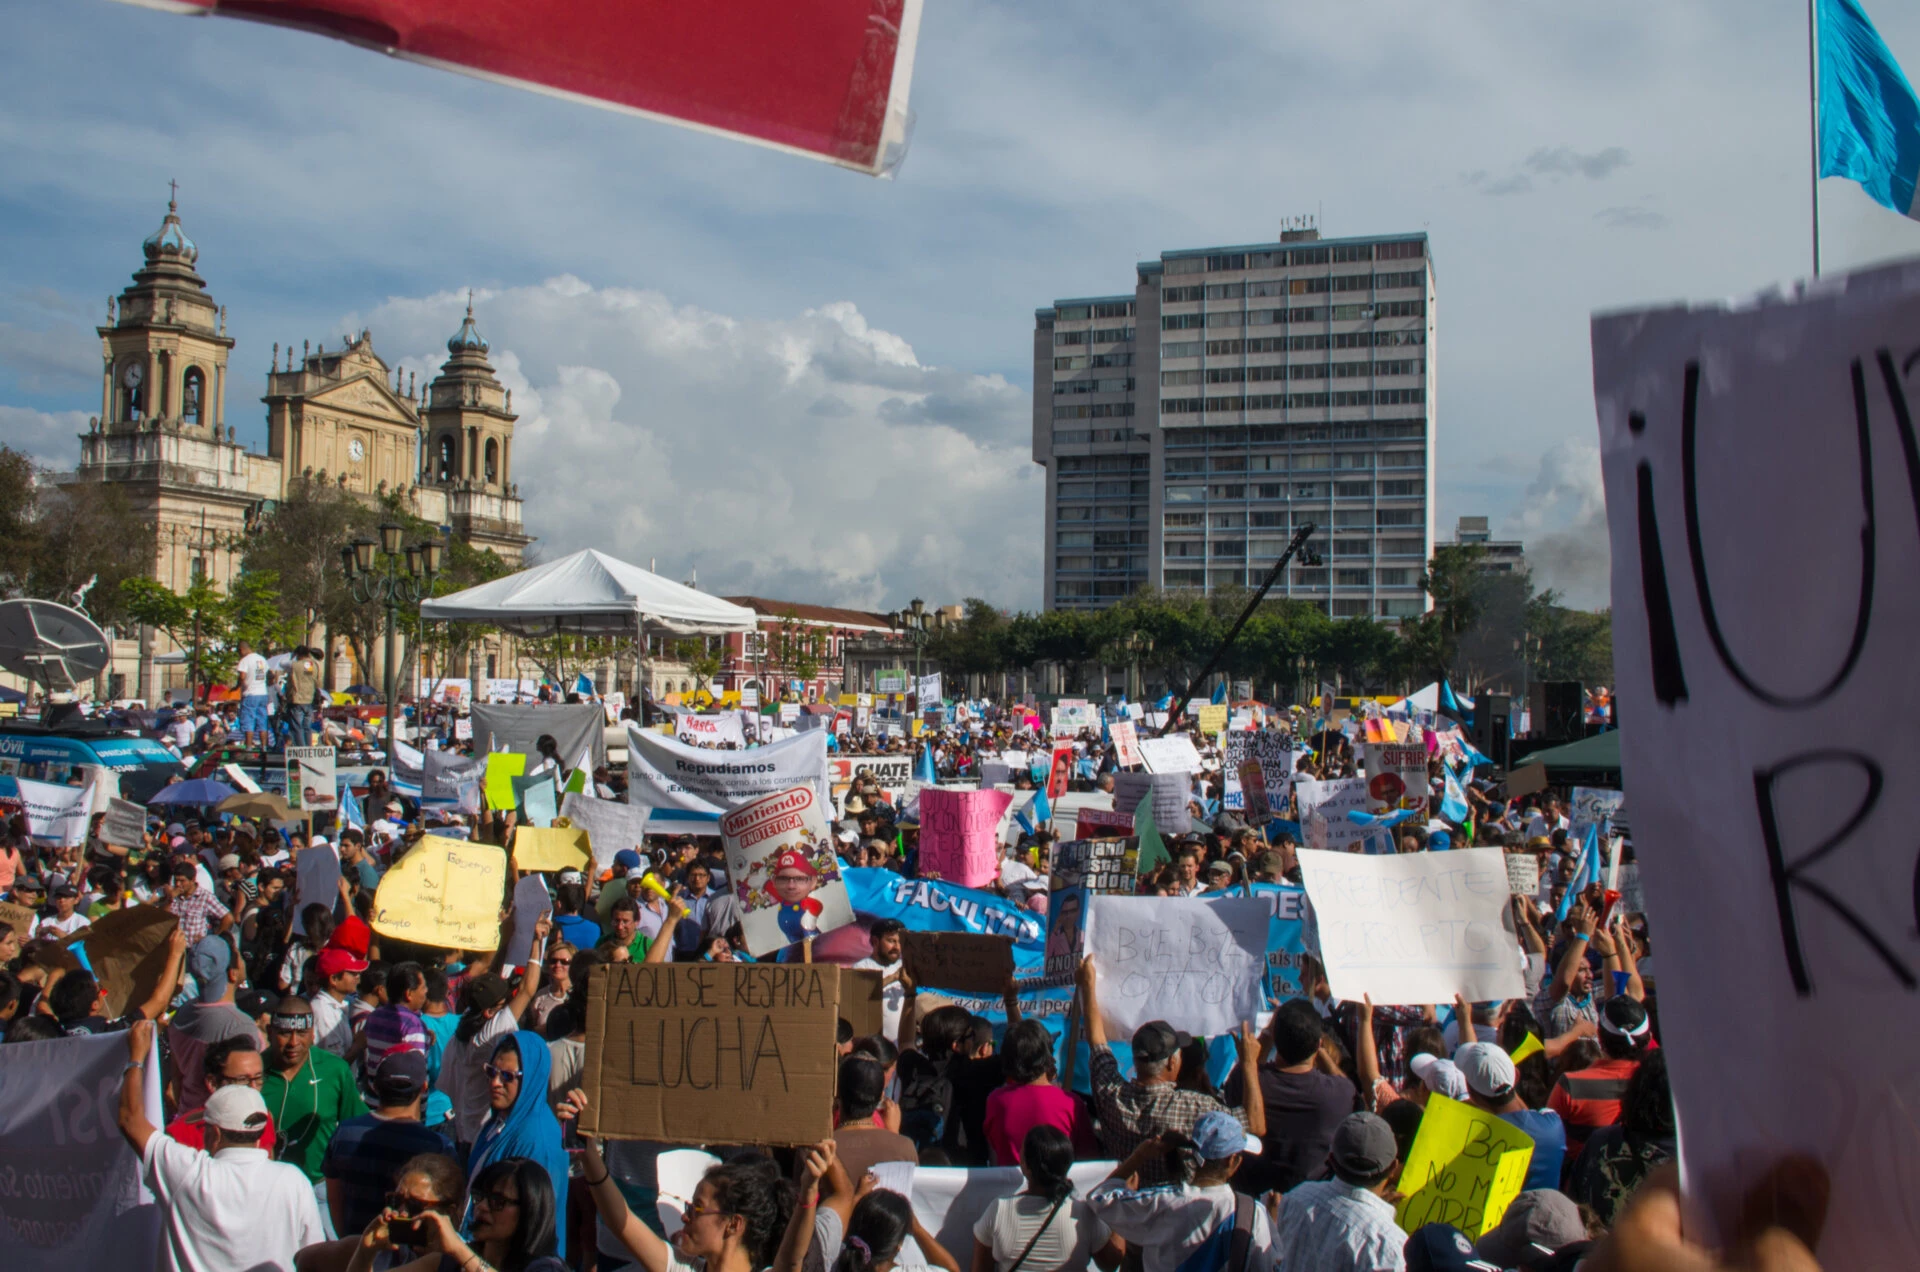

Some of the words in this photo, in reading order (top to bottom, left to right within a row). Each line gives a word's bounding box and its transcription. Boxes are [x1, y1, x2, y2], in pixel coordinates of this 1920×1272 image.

[1627, 347, 1920, 708] ¡U
[287, 748, 333, 759] #NOTETOCA
[676, 760, 776, 775] Repudiamos
[1383, 751, 1425, 765] SUFRIR
[715, 787, 783, 797] transparen
[728, 792, 806, 833] Mintiendo
[740, 813, 804, 849] #NOTETOCA
[1753, 748, 1920, 1000] R
[895, 881, 1039, 944] FACULTAD
[1270, 948, 1290, 967] aís
[615, 967, 677, 1008] AQUI
[687, 967, 717, 1008] SE
[734, 966, 825, 1008] RESPIRA
[630, 1014, 788, 1093] LUCHA
[1426, 1160, 1457, 1193] NO
